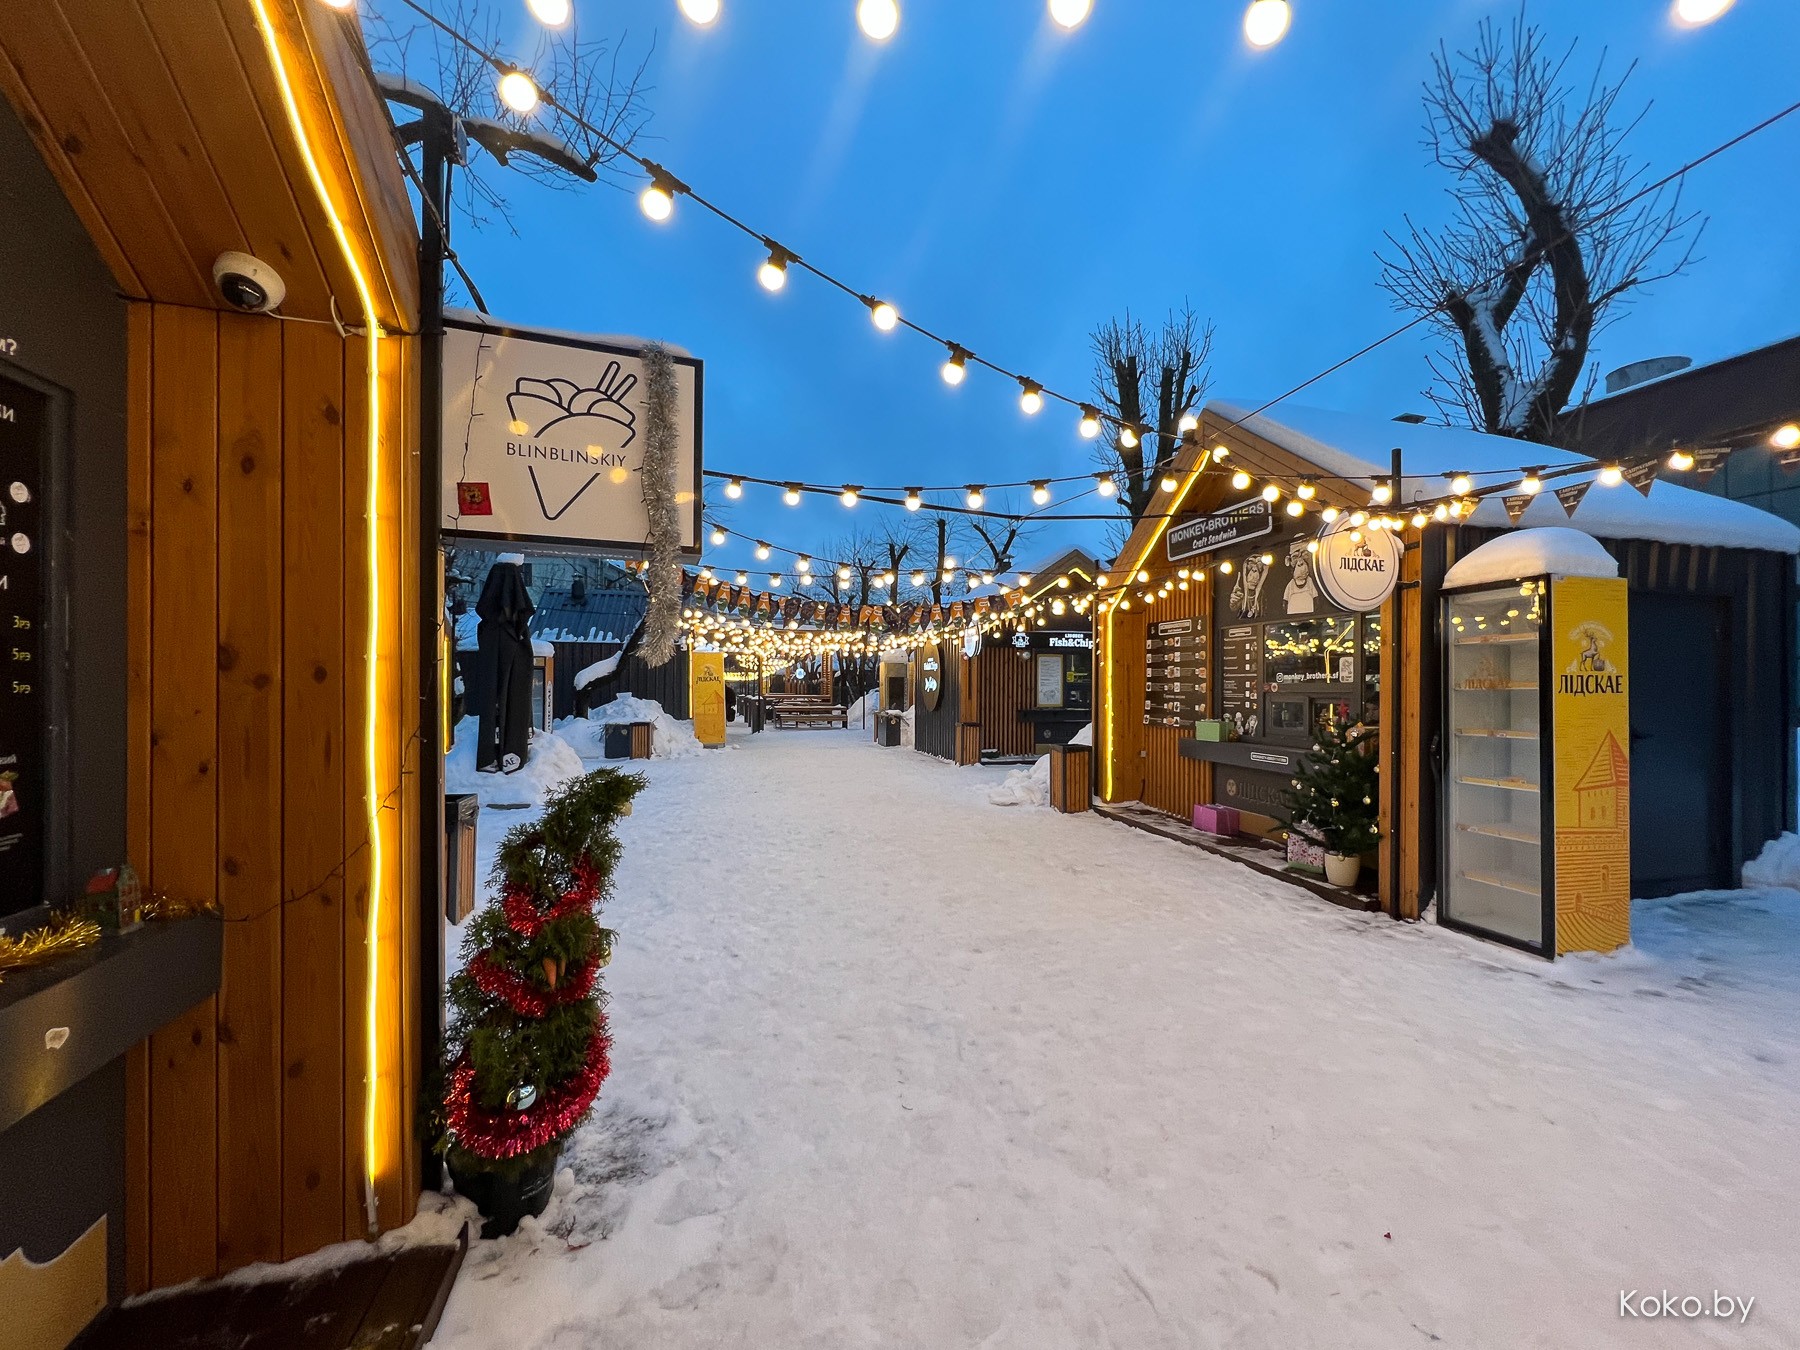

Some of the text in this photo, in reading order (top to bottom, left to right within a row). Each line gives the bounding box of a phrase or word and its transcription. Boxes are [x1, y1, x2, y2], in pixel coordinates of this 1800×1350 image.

[506, 442, 627, 467] BLINBLINSKIY
[1171, 502, 1265, 544] MONKEY-BROTHERS
[1192, 527, 1237, 549] Craft Sandwich
[1339, 556, 1385, 573] ЛІДСКАЕ
[1049, 637, 1093, 649] Fish&Chip
[1558, 674, 1624, 697] ЛІДСКАЕ
